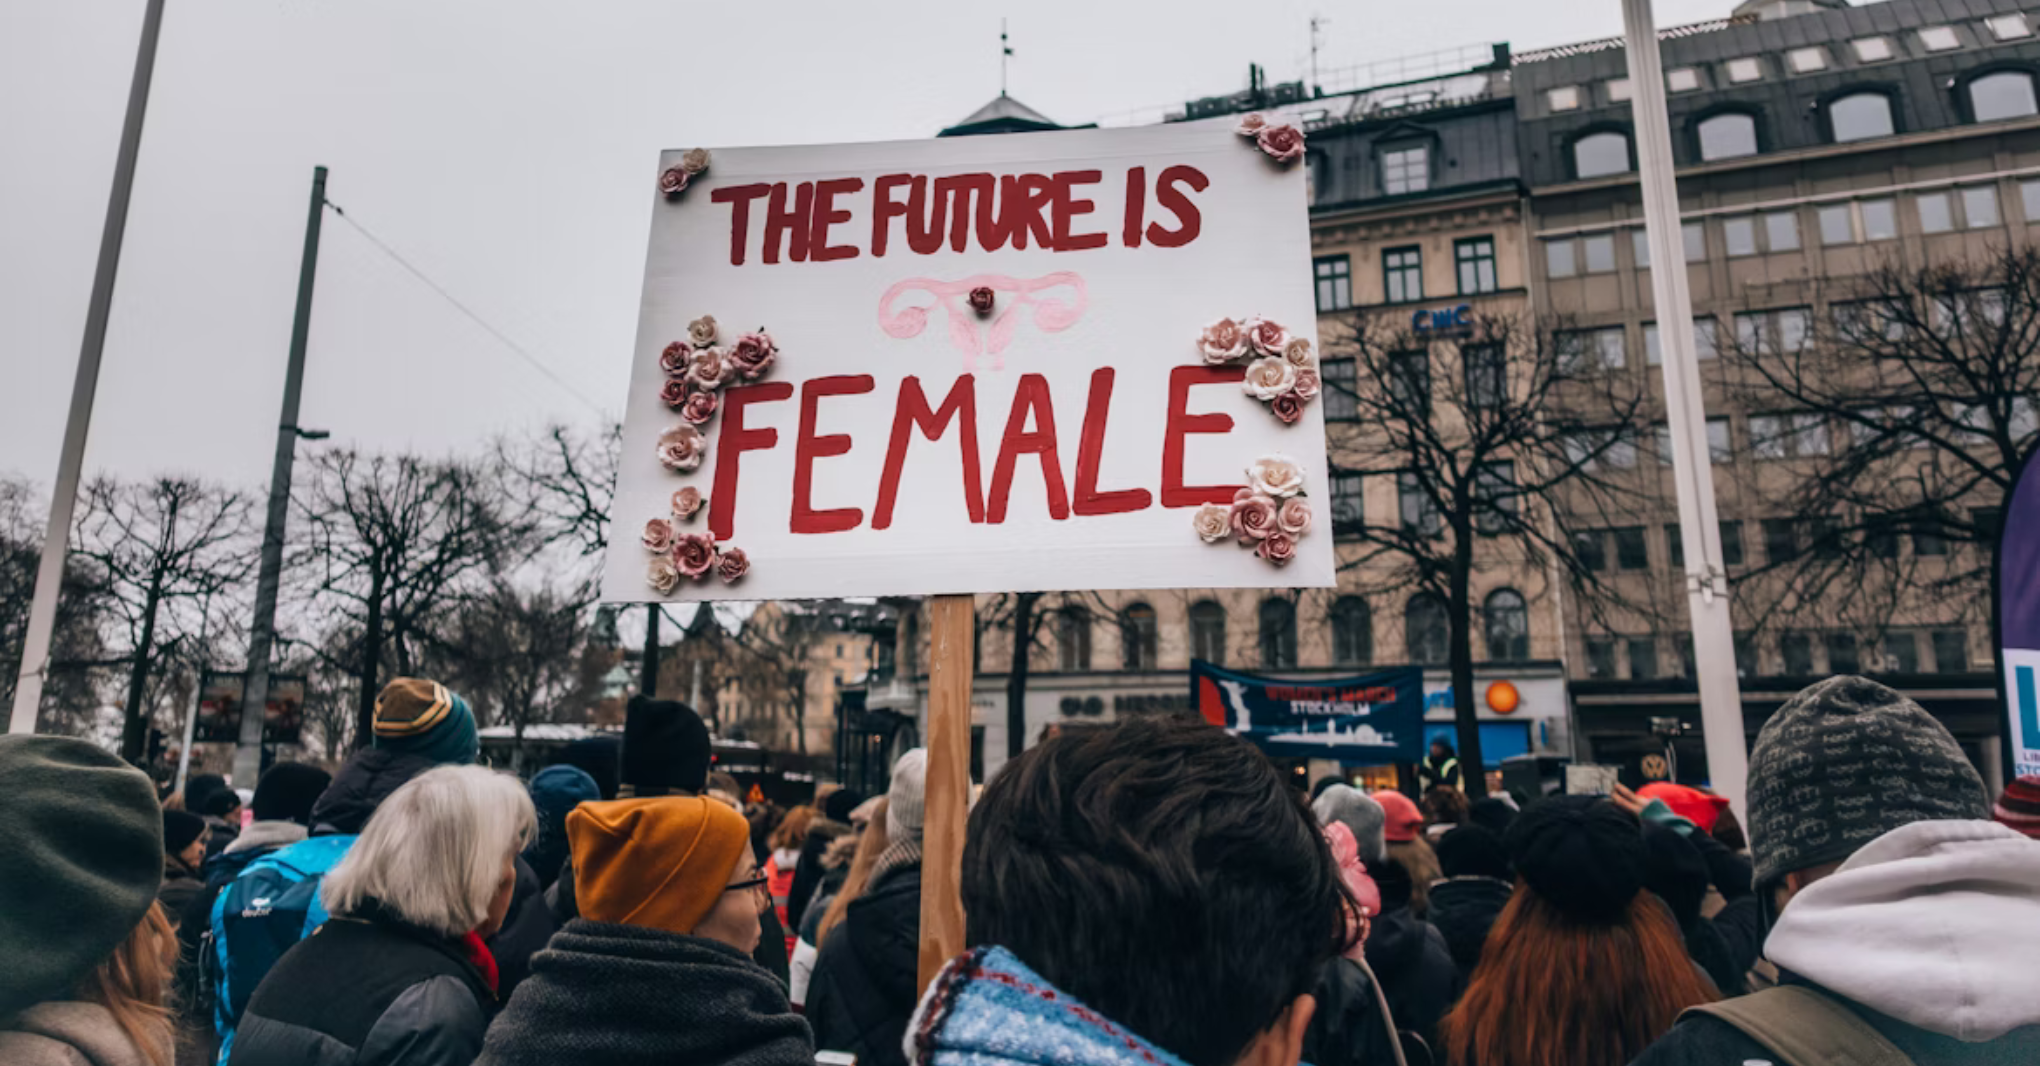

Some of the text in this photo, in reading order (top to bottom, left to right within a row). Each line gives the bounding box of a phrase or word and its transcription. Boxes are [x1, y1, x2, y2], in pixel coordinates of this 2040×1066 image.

[711, 164, 1210, 265] THE FUTURE IS
[708, 366, 1247, 542] FEMALE
[1290, 700, 1371, 717] STOCKHOLM
[1340, 686, 1396, 702] MARCH
